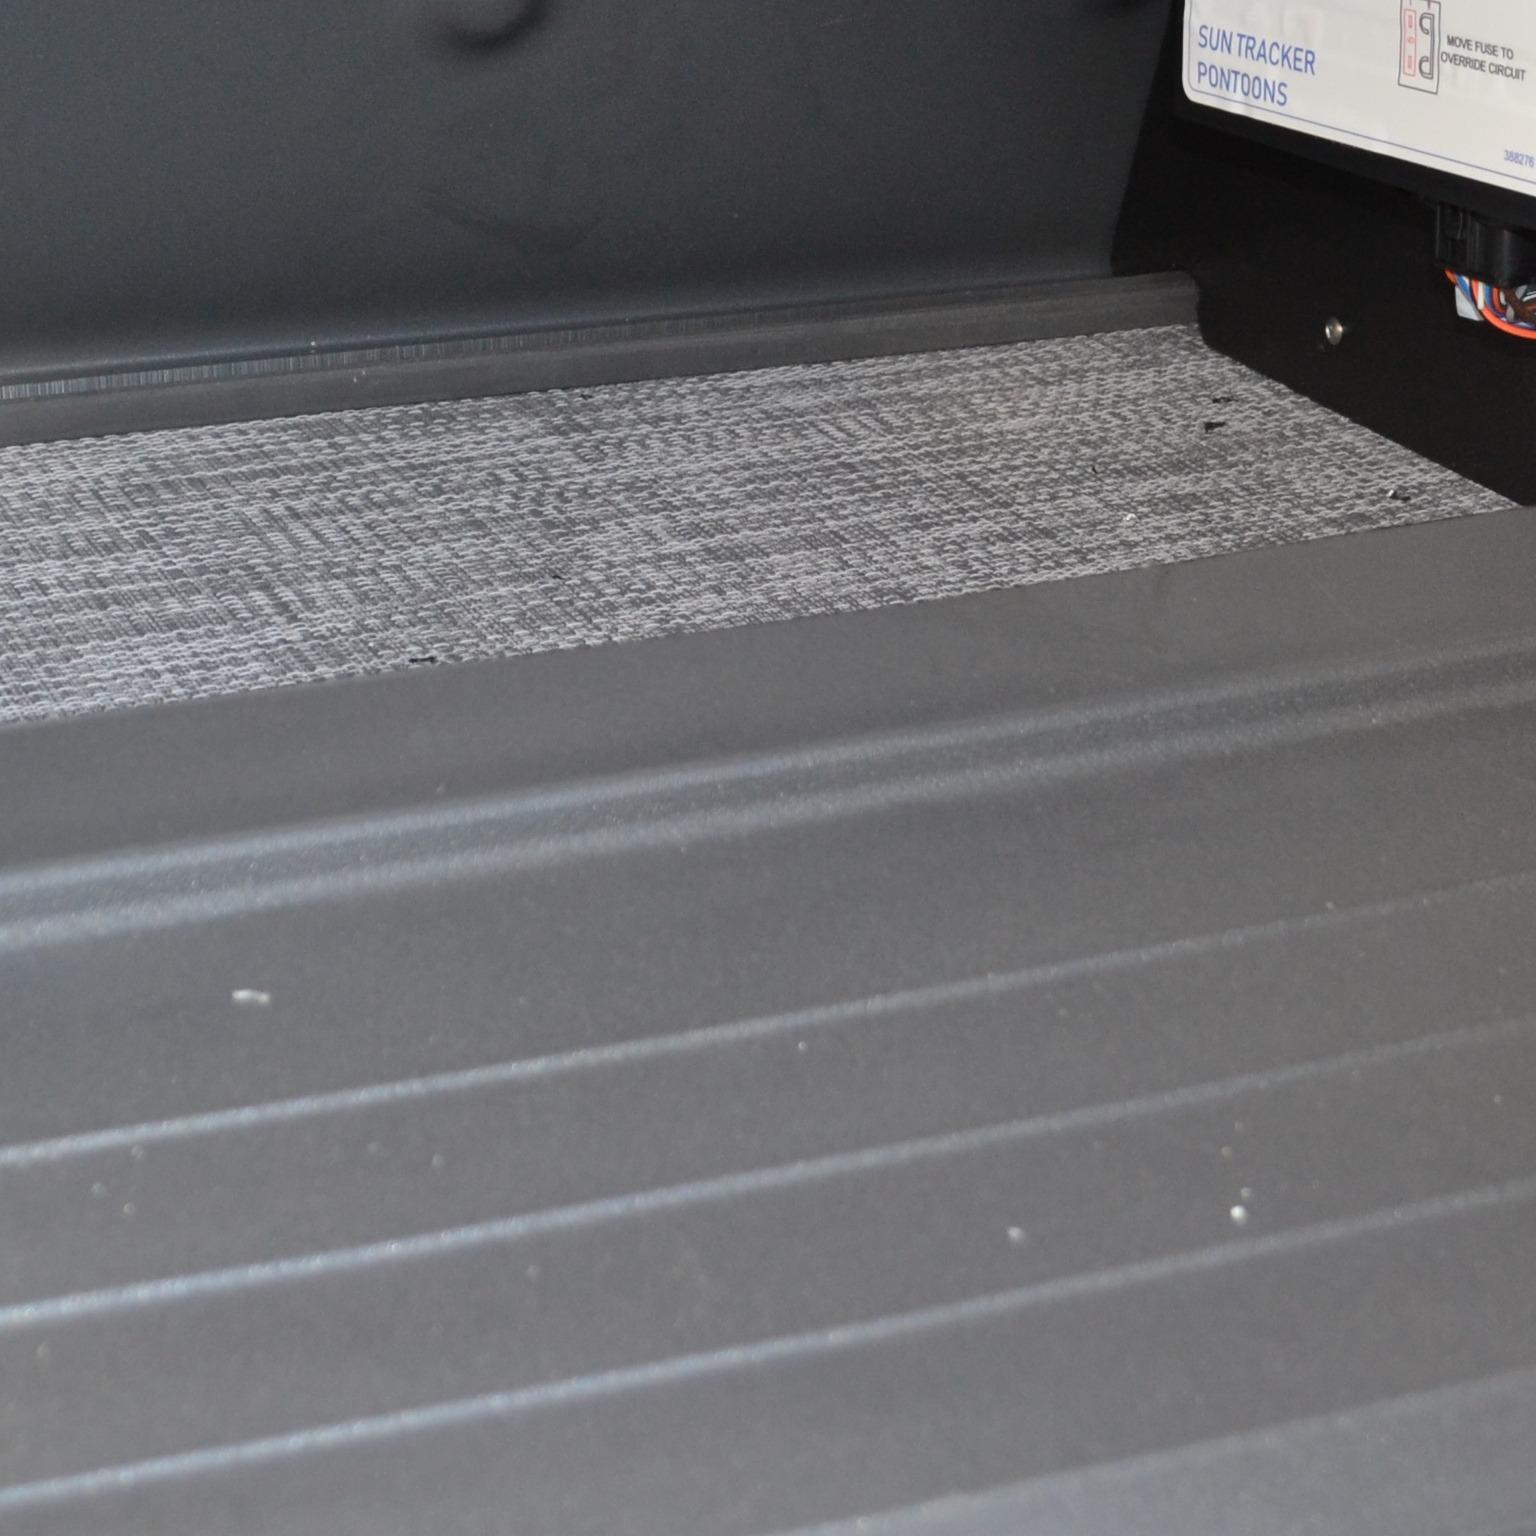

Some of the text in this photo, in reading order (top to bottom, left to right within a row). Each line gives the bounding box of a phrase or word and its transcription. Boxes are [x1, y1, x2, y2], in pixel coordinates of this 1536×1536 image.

[1197, 24, 1316, 76] SUN TRACKER
[1440, 51, 1526, 81] OVERRIDE CIRCUIT
[1446, 34, 1514, 60] MOVE FUSE TO
[1197, 61, 1288, 107] PONTOONS
